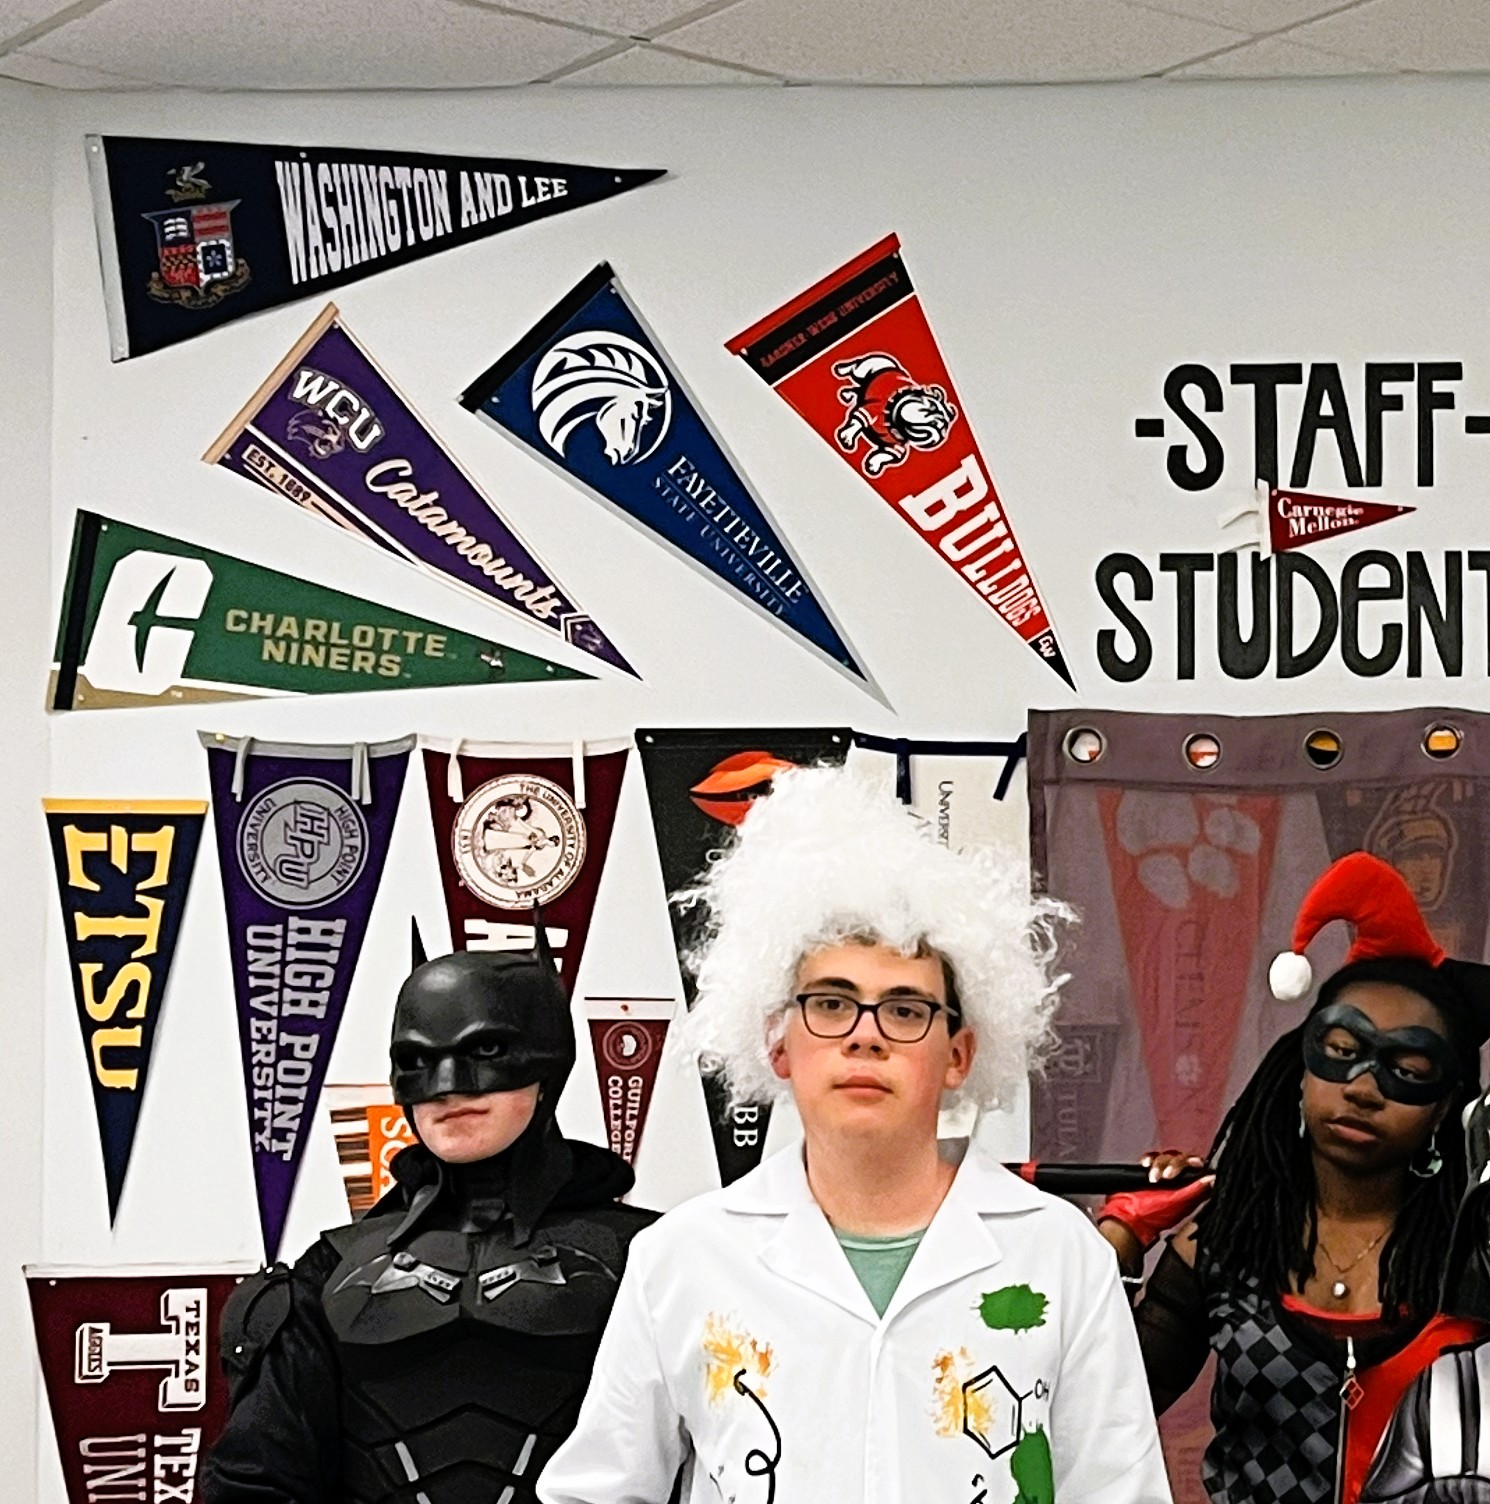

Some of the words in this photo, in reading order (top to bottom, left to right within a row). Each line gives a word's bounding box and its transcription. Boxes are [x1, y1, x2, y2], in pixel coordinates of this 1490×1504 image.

[275, 161, 452, 284] WASHINGTON
[460, 171, 514, 227] AND
[517, 176, 568, 208] LEE
[291, 369, 383, 451] WCU
[366, 459, 561, 620] Catamounts
[653, 477, 696, 522] STATE
[700, 524, 786, 616] UNIVERSITY
[667, 455, 809, 604] FAYETTEVILLE
[898, 454, 1043, 627] BULLDOGS
[1276, 497, 1365, 519] Carnegie
[1288, 516, 1356, 538] Mellon
[225, 609, 447, 657] CHARLOTTE
[262, 639, 402, 677] NINERS
[246, 797, 278, 883] UNIVERSITY
[62, 824, 174, 1091] ETSU
[281, 916, 347, 1019] HIGH
[246, 923, 283, 1152] UNIVERSITY
[270, 1027, 323, 1161] POINT
[1057, 1090, 1077, 1158] TULA
[184, 1300, 201, 1393] TEXAS
